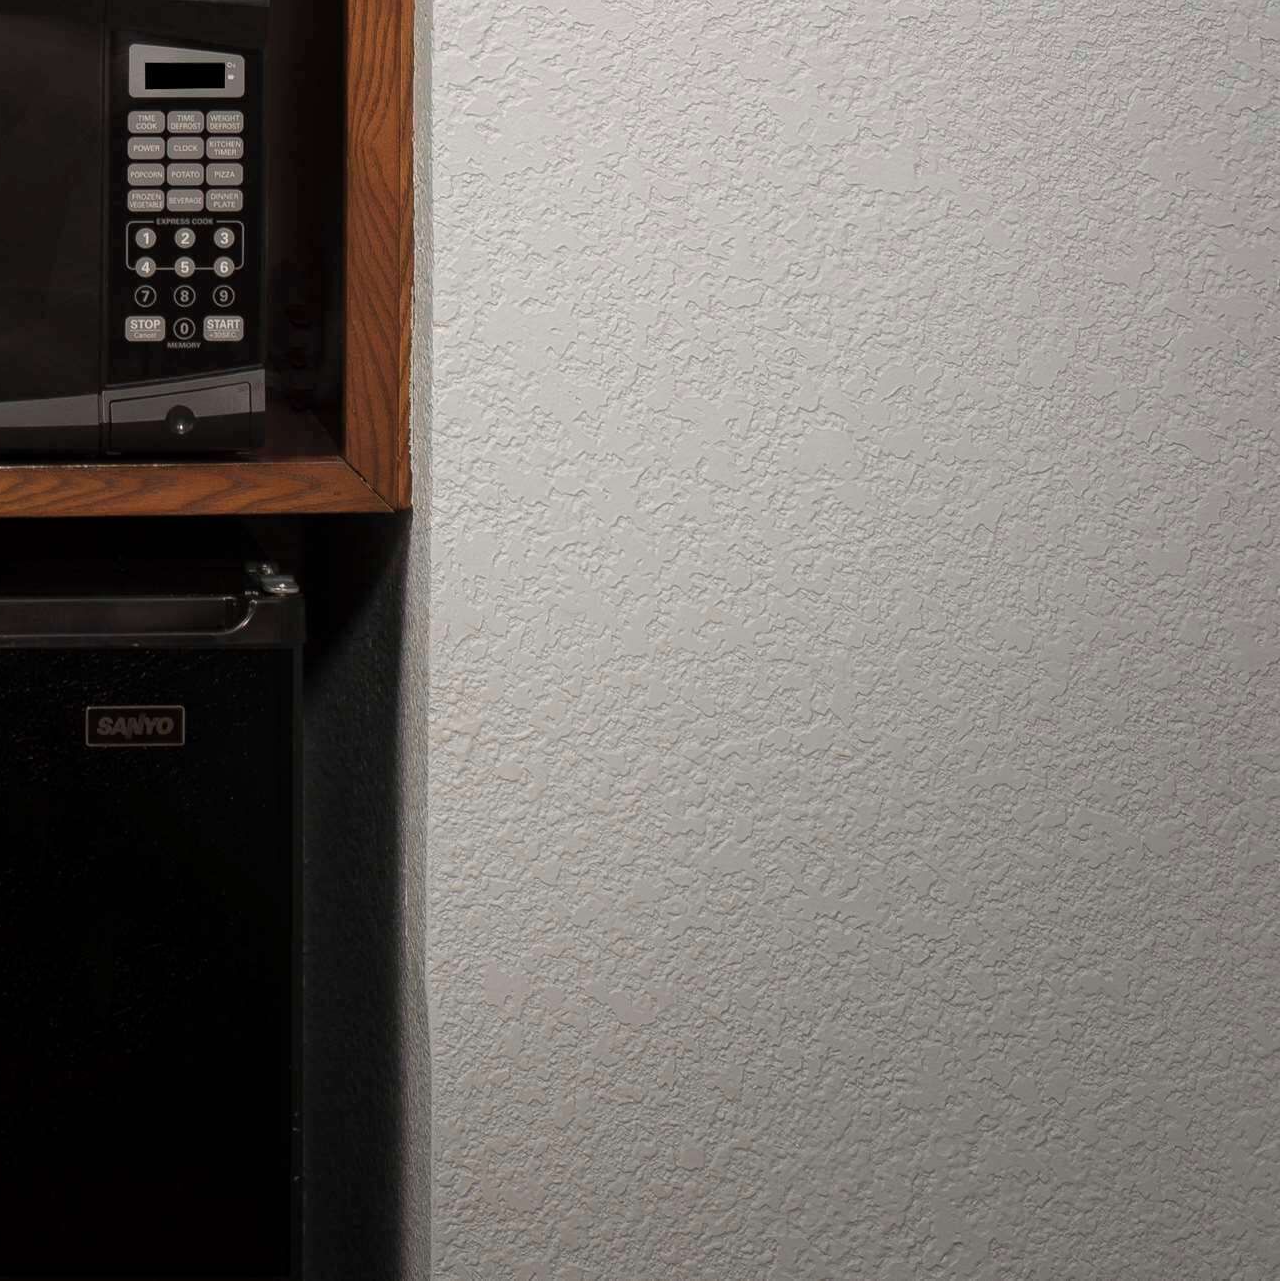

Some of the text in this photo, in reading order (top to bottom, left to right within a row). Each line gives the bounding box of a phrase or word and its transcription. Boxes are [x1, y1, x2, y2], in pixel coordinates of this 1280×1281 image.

[138, 114, 156, 122] TIME
[177, 114, 195, 122] TIME
[209, 114, 240, 122] WEIGHT
[135, 122, 158, 130] COOK
[170, 122, 201, 130] DEFROST
[209, 122, 241, 130] DEFROST
[133, 144, 160, 152] POWER
[173, 144, 198, 152] CLOCK
[209, 140, 241, 148] KITCHEN
[214, 148, 237, 156] TIMER
[130, 170, 163, 179] POPCORN
[171, 170, 201, 178] POTATO
[214, 170, 235, 178] PIZZA
[169, 197, 202, 205] BEVERAGE
[143, 232, 150, 245] 1
[180, 232, 190, 245] 2
[220, 232, 229, 245] 3
[141, 261, 150, 274] 4
[180, 261, 190, 274] 5
[220, 261, 229, 274] 6
[141, 290, 150, 302] 7
[180, 290, 190, 302] 8
[219, 290, 229, 302] 9
[130, 319, 161, 330] STOP
[180, 322, 189, 335] 0
[207, 319, 241, 330] START
[96, 713, 175, 739] SANYO
